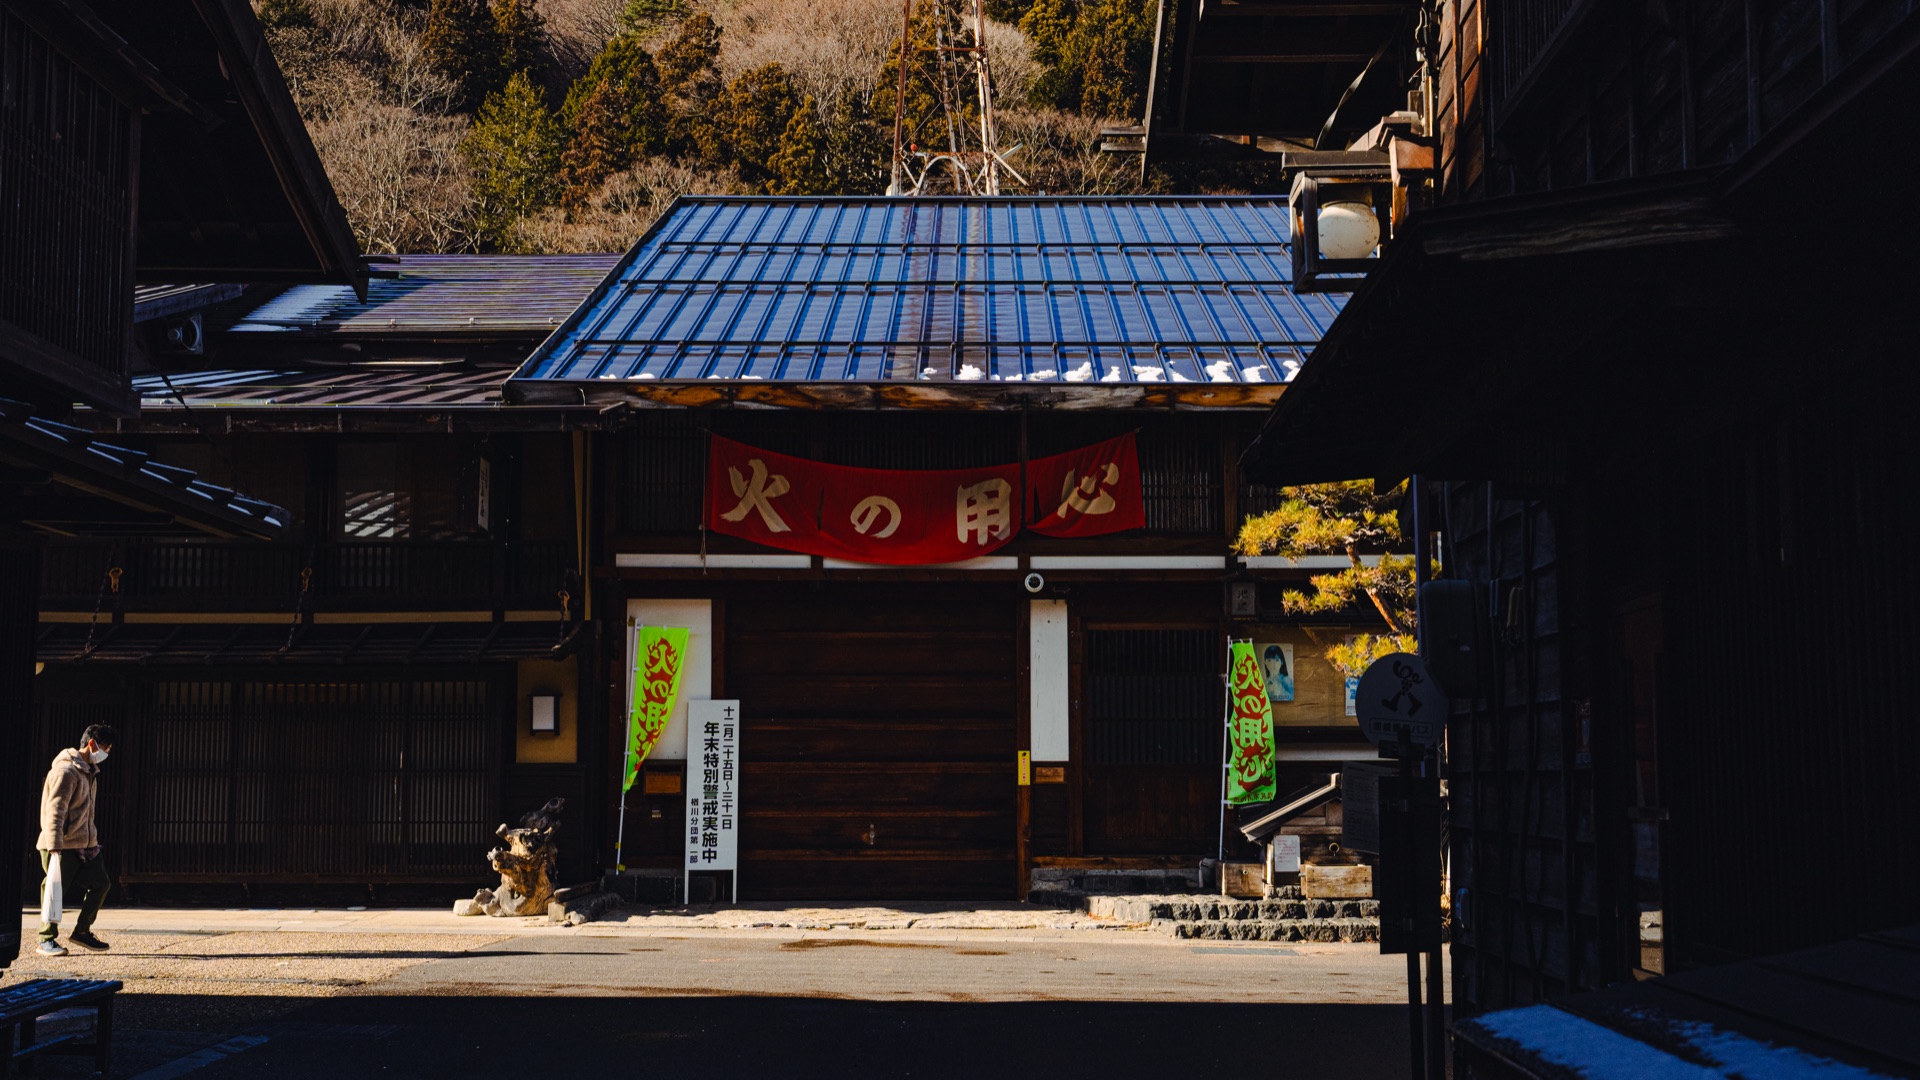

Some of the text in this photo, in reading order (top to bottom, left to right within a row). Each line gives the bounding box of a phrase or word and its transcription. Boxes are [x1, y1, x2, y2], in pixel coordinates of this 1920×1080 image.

[719, 458, 1120, 546] 火の用心
[702, 721, 720, 864] 年末特別警戒実施中
